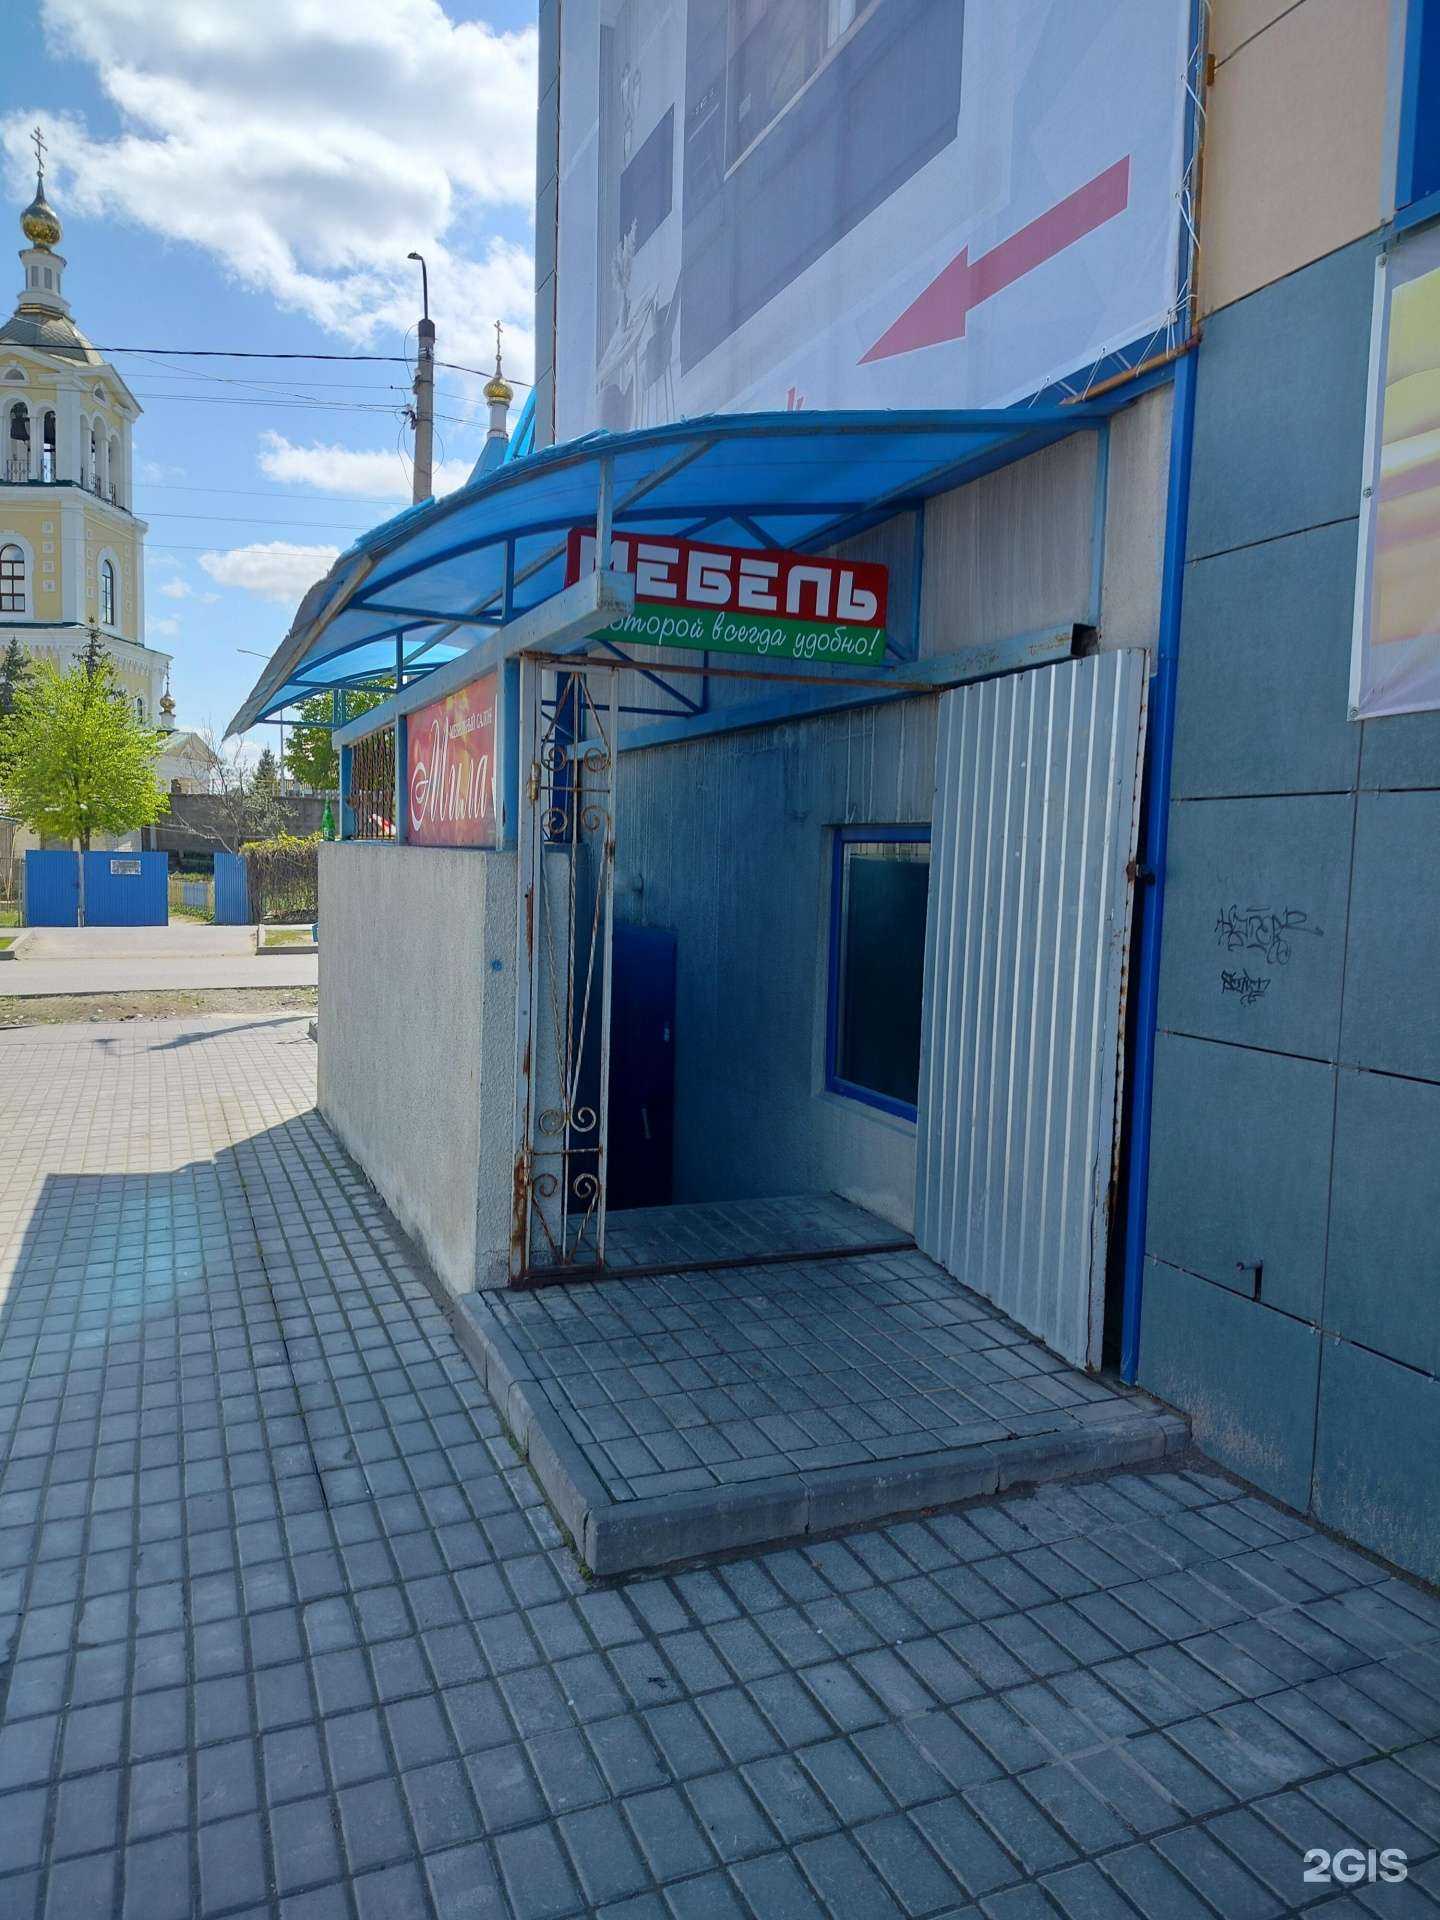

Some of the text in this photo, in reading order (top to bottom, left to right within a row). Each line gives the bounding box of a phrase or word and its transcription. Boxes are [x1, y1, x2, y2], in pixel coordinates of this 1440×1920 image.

[609, 611, 881, 657] оторой всегда удобно!
